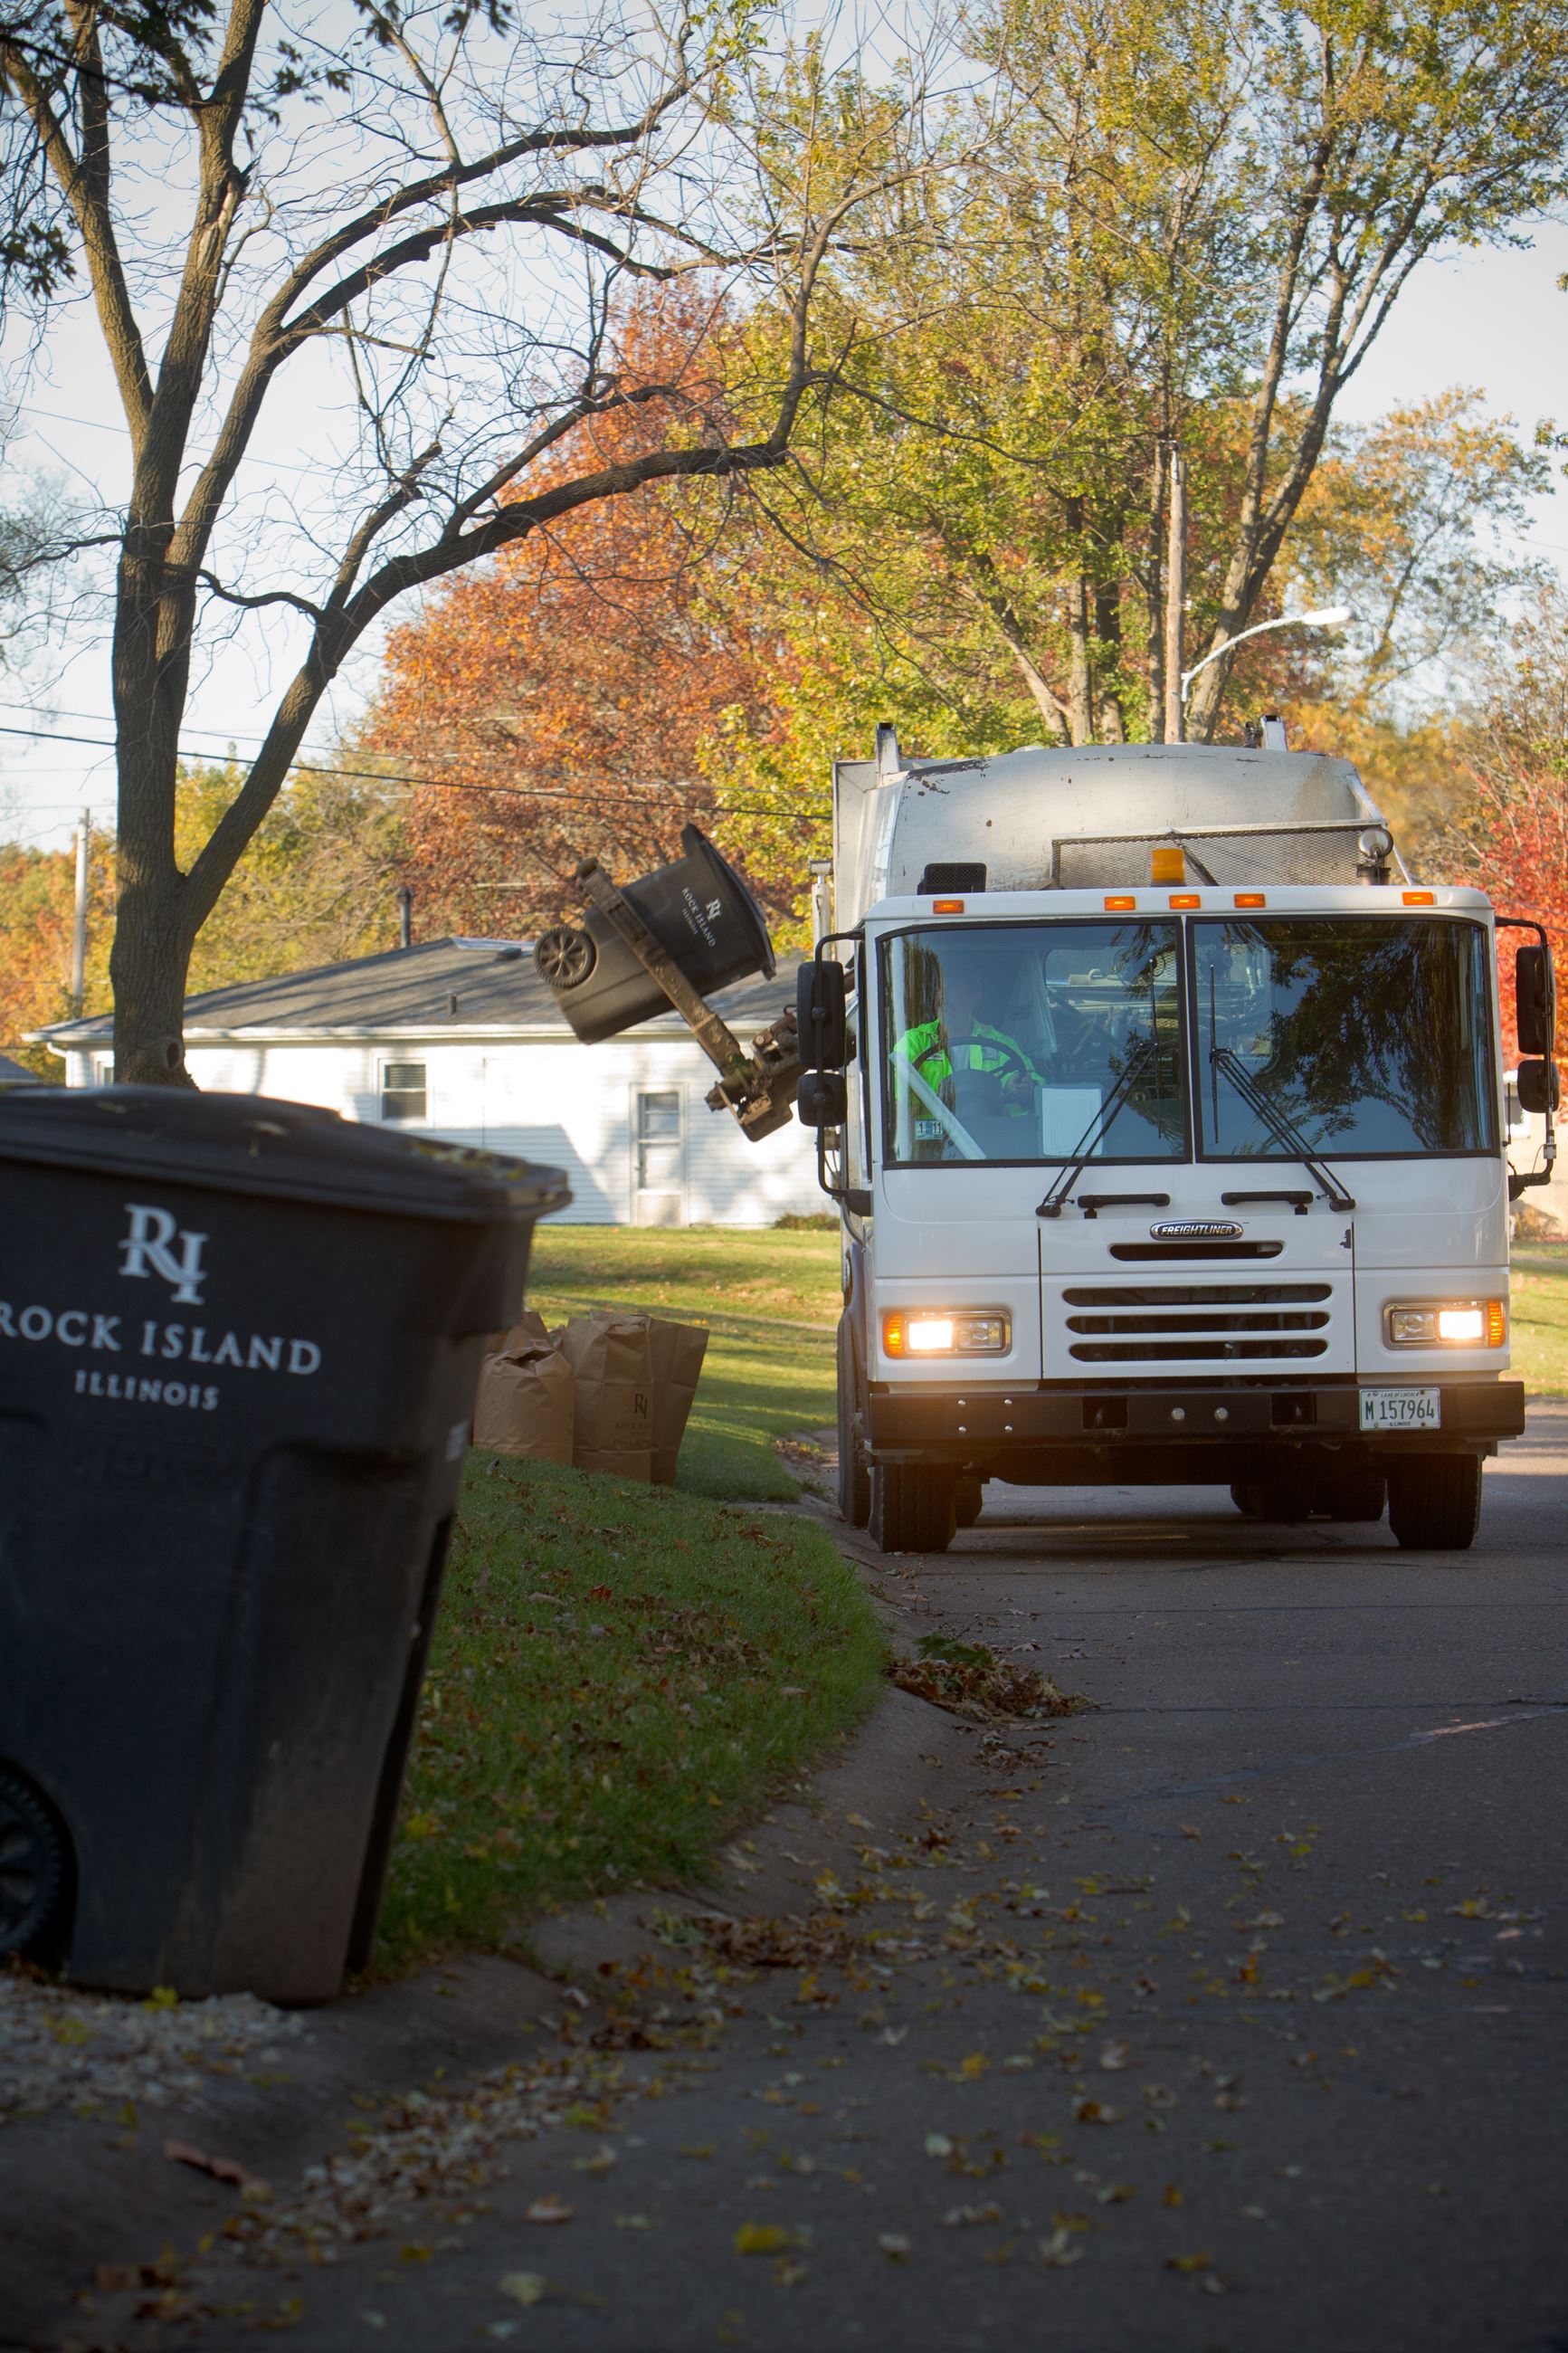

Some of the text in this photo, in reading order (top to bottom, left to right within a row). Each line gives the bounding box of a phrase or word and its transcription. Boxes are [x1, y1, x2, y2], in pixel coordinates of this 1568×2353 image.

[681, 887, 716, 948] ROCK ISLAND
[1161, 1224, 1232, 1235] FREIGHTLINER
[0, 1301, 322, 1375] ROCK ISLAND
[74, 1369, 220, 1411] ILLINOIS
[1365, 1399, 1435, 1420] M 157964
